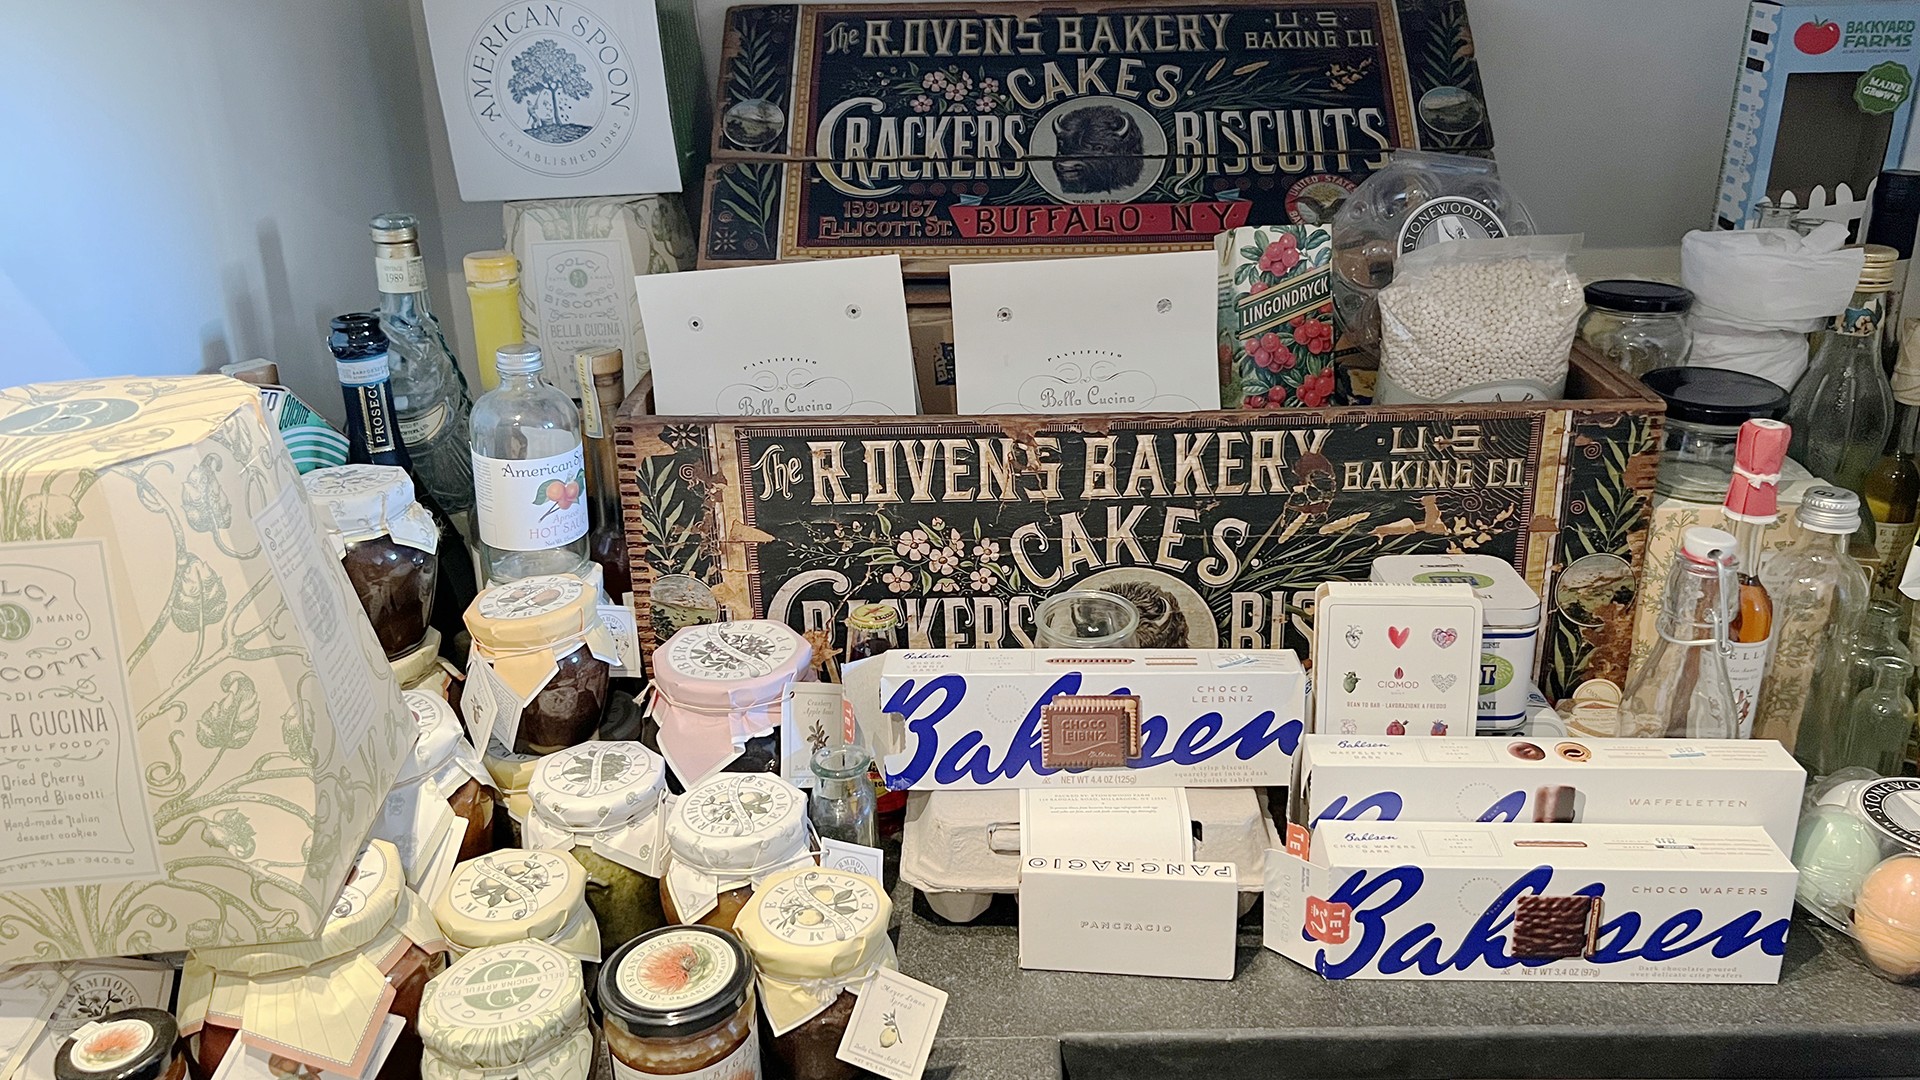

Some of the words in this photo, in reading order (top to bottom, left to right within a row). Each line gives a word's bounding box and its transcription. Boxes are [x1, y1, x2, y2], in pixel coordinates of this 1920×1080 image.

[825, 21, 860, 55] The
[1057, 14, 1231, 54] BAKERY
[1845, 19, 1916, 34] BACKYARD
[1244, 31, 1336, 49] BAKING
[1842, 33, 1913, 48] FARMS
[474, 6, 564, 122] AMERICAN
[572, 14, 631, 112] SPOON
[1868, 76, 1904, 94] MAINE
[1862, 85, 1901, 103] GROWN
[499, 130, 597, 166] ESTABLISHED
[600, 122, 622, 150] 1982
[815, 97, 1027, 198] CRACKERS
[1174, 107, 1393, 195] BISCUITS
[976, 205, 1142, 237] BUFFALO
[1403, 202, 1483, 249] STONEWOOD
[554, 258, 601, 274] DOLCI
[544, 293, 619, 309] BISCOTTI
[1242, 275, 1330, 326] LINGONDRYCK
[550, 324, 582, 338] BELLA
[584, 322, 621, 337] CUCINA
[738, 396, 780, 416] Bella
[784, 392, 833, 413] Cucina
[1040, 387, 1082, 408] Bella
[1087, 385, 1136, 405] Cucina
[501, 460, 573, 479] American
[751, 444, 804, 502] The
[1080, 428, 1335, 502] BAKERY
[1343, 460, 1477, 491] BAKING
[529, 525, 559, 540] HOT
[46, 613, 83, 623] MANO
[903, 652, 951, 661] Bahlsen
[1197, 685, 1250, 694] CHOCO
[1377, 680, 1420, 690] CIOMOD
[15, 692, 33, 702] DI
[1191, 694, 1254, 704] LEIBNIZ
[30, 707, 109, 738] CUCINA
[1061, 719, 1108, 730] CHOCO
[881, 671, 1304, 792] Bahsen
[1062, 729, 1108, 746] LEIBNIZ
[49, 739, 92, 750] FOOD
[1338, 740, 1390, 749] Bahlsen
[2, 773, 36, 791] Dried
[41, 771, 86, 789] Cherry
[1061, 776, 1075, 784] NET
[1075, 776, 1089, 784] WT
[1090, 776, 1103, 784] 4.4
[1104, 776, 1114, 784] OZ
[1114, 775, 1137, 786] (125g)
[1, 792, 49, 809] Almond
[54, 789, 105, 806] Biscotti
[1629, 798, 1748, 808] WAFFELETTEN
[4, 817, 64, 831] Hand-made
[66, 812, 101, 827] Italian
[17, 832, 54, 842] dessert
[58, 827, 98, 840] cookies
[1344, 833, 1398, 841] Bahlsen
[528, 852, 565, 880] KEY
[1028, 857, 1232, 878] PANCRACIO
[455, 878, 499, 919] LIME
[1631, 886, 1689, 895] CHOCO
[1699, 886, 1769, 896] WAFERS
[1080, 919, 1173, 933] PANCRACIO
[1522, 967, 1538, 976] NET
[1540, 967, 1553, 976] WT
[1554, 967, 1568, 977] 3.4
[1569, 968, 1580, 977] OZ
[1580, 967, 1601, 978] (97g)
